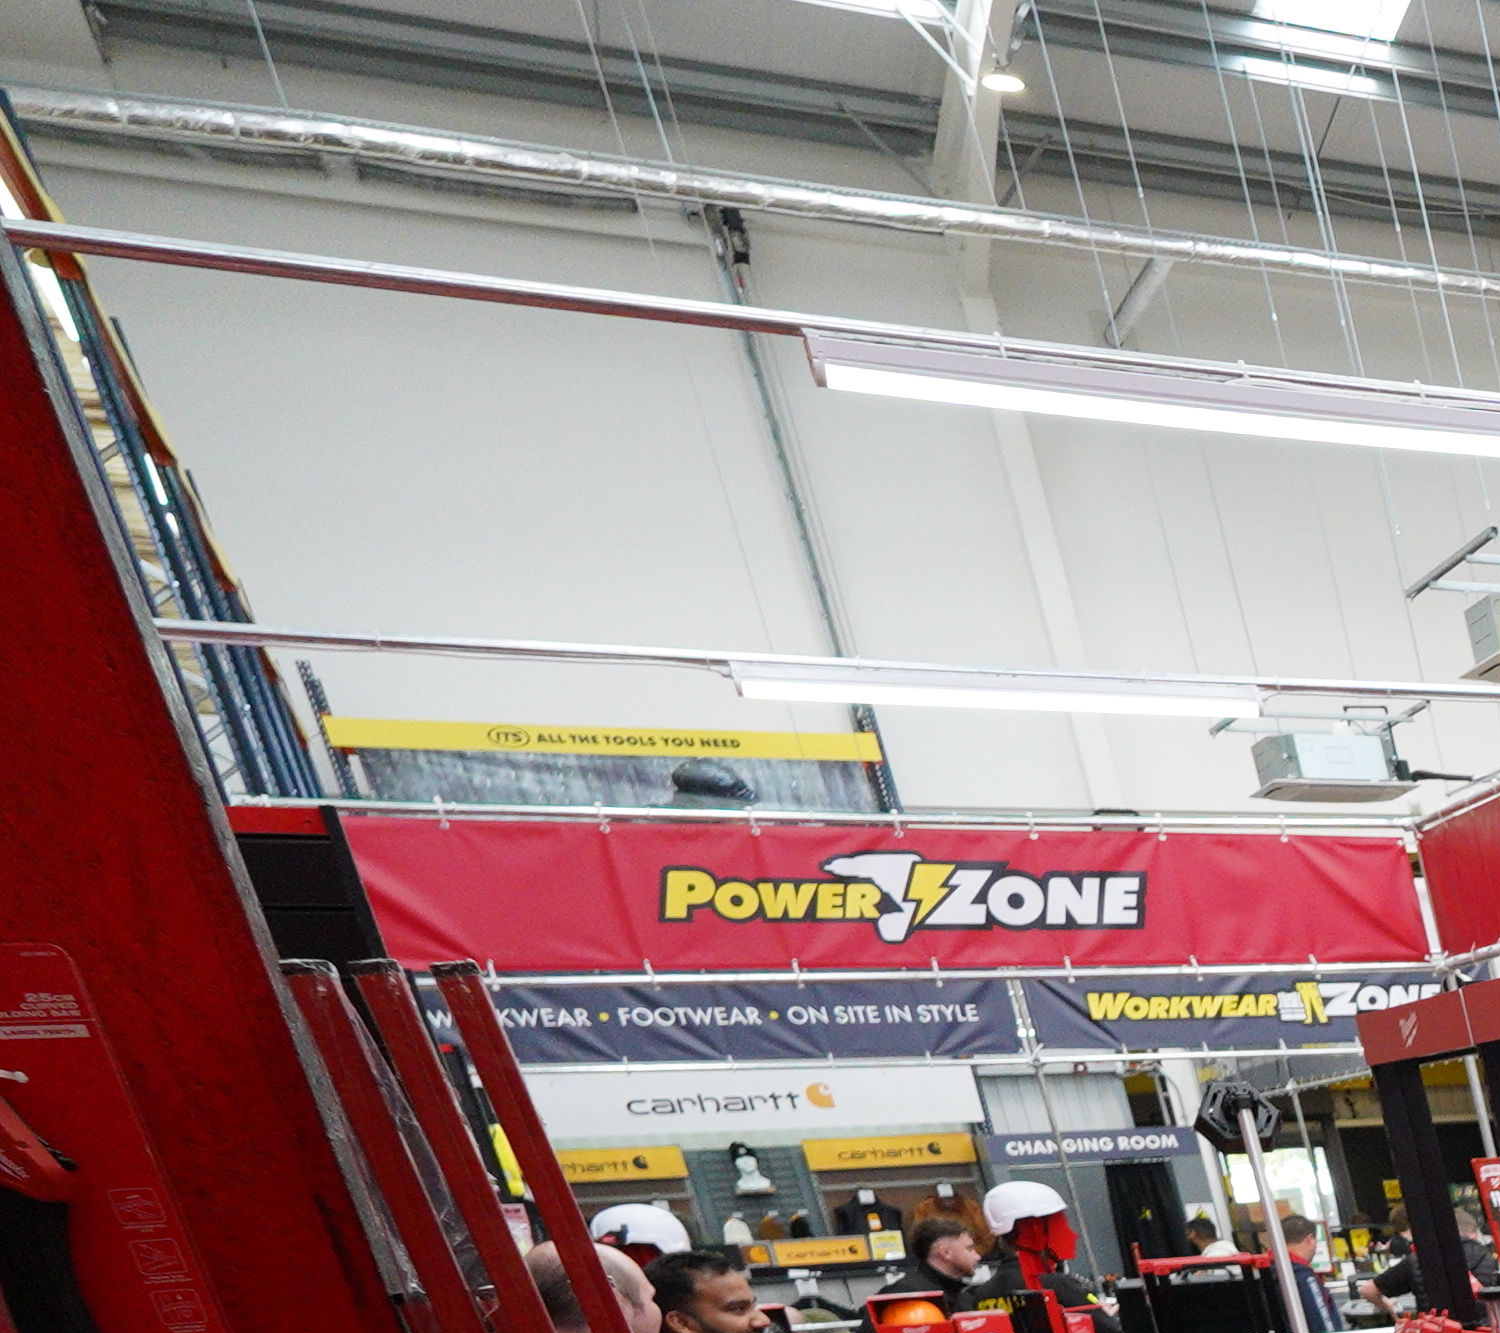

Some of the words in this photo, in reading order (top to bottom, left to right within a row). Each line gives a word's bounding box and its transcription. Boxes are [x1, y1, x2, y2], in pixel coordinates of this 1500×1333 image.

[494, 729, 526, 745] ITS
[537, 733, 566, 745] ALL
[571, 733, 597, 746] THE
[600, 734, 656, 747] TOOLS
[661, 735, 693, 748] YOU
[697, 735, 741, 749] NEED
[664, 870, 881, 921] POWER
[944, 870, 1143, 926] ZONE
[428, 1007, 591, 1029] WKWEAR
[618, 1006, 762, 1027] FOOTWEAR
[787, 1006, 831, 1026] ON
[834, 1005, 881, 1025] SITE
[886, 1004, 910, 1024] IN
[914, 1003, 980, 1024] STYLE
[1088, 990, 1278, 1022] WORKWEAR
[626, 1089, 800, 1116] carhartt
[1005, 1136, 1114, 1157] CHANGING
[1117, 1133, 1179, 1151] ROOM
